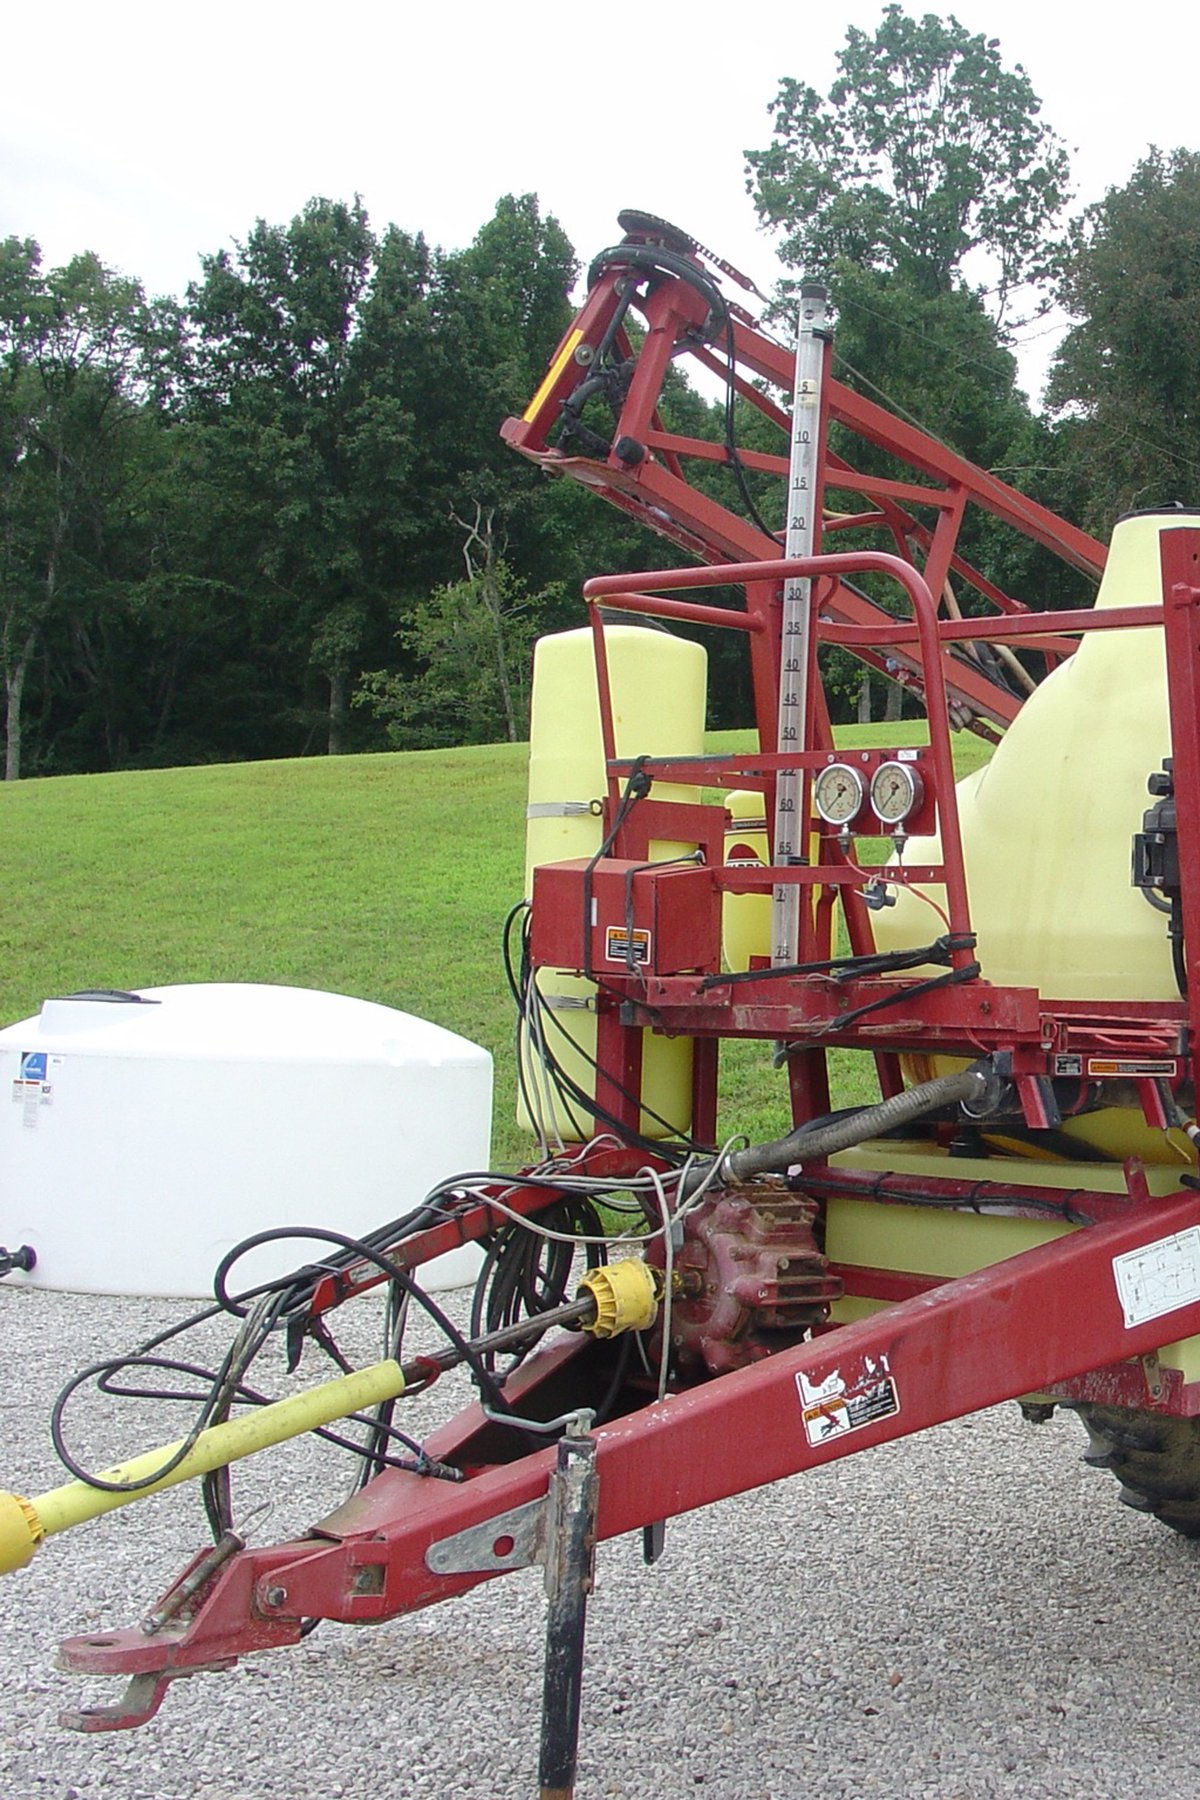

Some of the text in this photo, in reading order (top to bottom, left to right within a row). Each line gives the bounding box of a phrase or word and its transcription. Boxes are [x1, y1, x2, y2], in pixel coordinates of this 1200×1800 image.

[801, 381, 809, 392] 5
[797, 430, 809, 442] 10
[794, 477, 807, 488] 15
[792, 517, 805, 528] 20
[789, 587, 802, 599] 30
[787, 621, 800, 633] 35
[786, 658, 799, 669] 40
[784, 693, 798, 704] 45
[783, 727, 796, 738] 50
[780, 798, 793, 810] 60
[779, 842, 792, 854] 65
[776, 945, 789, 957] 75
